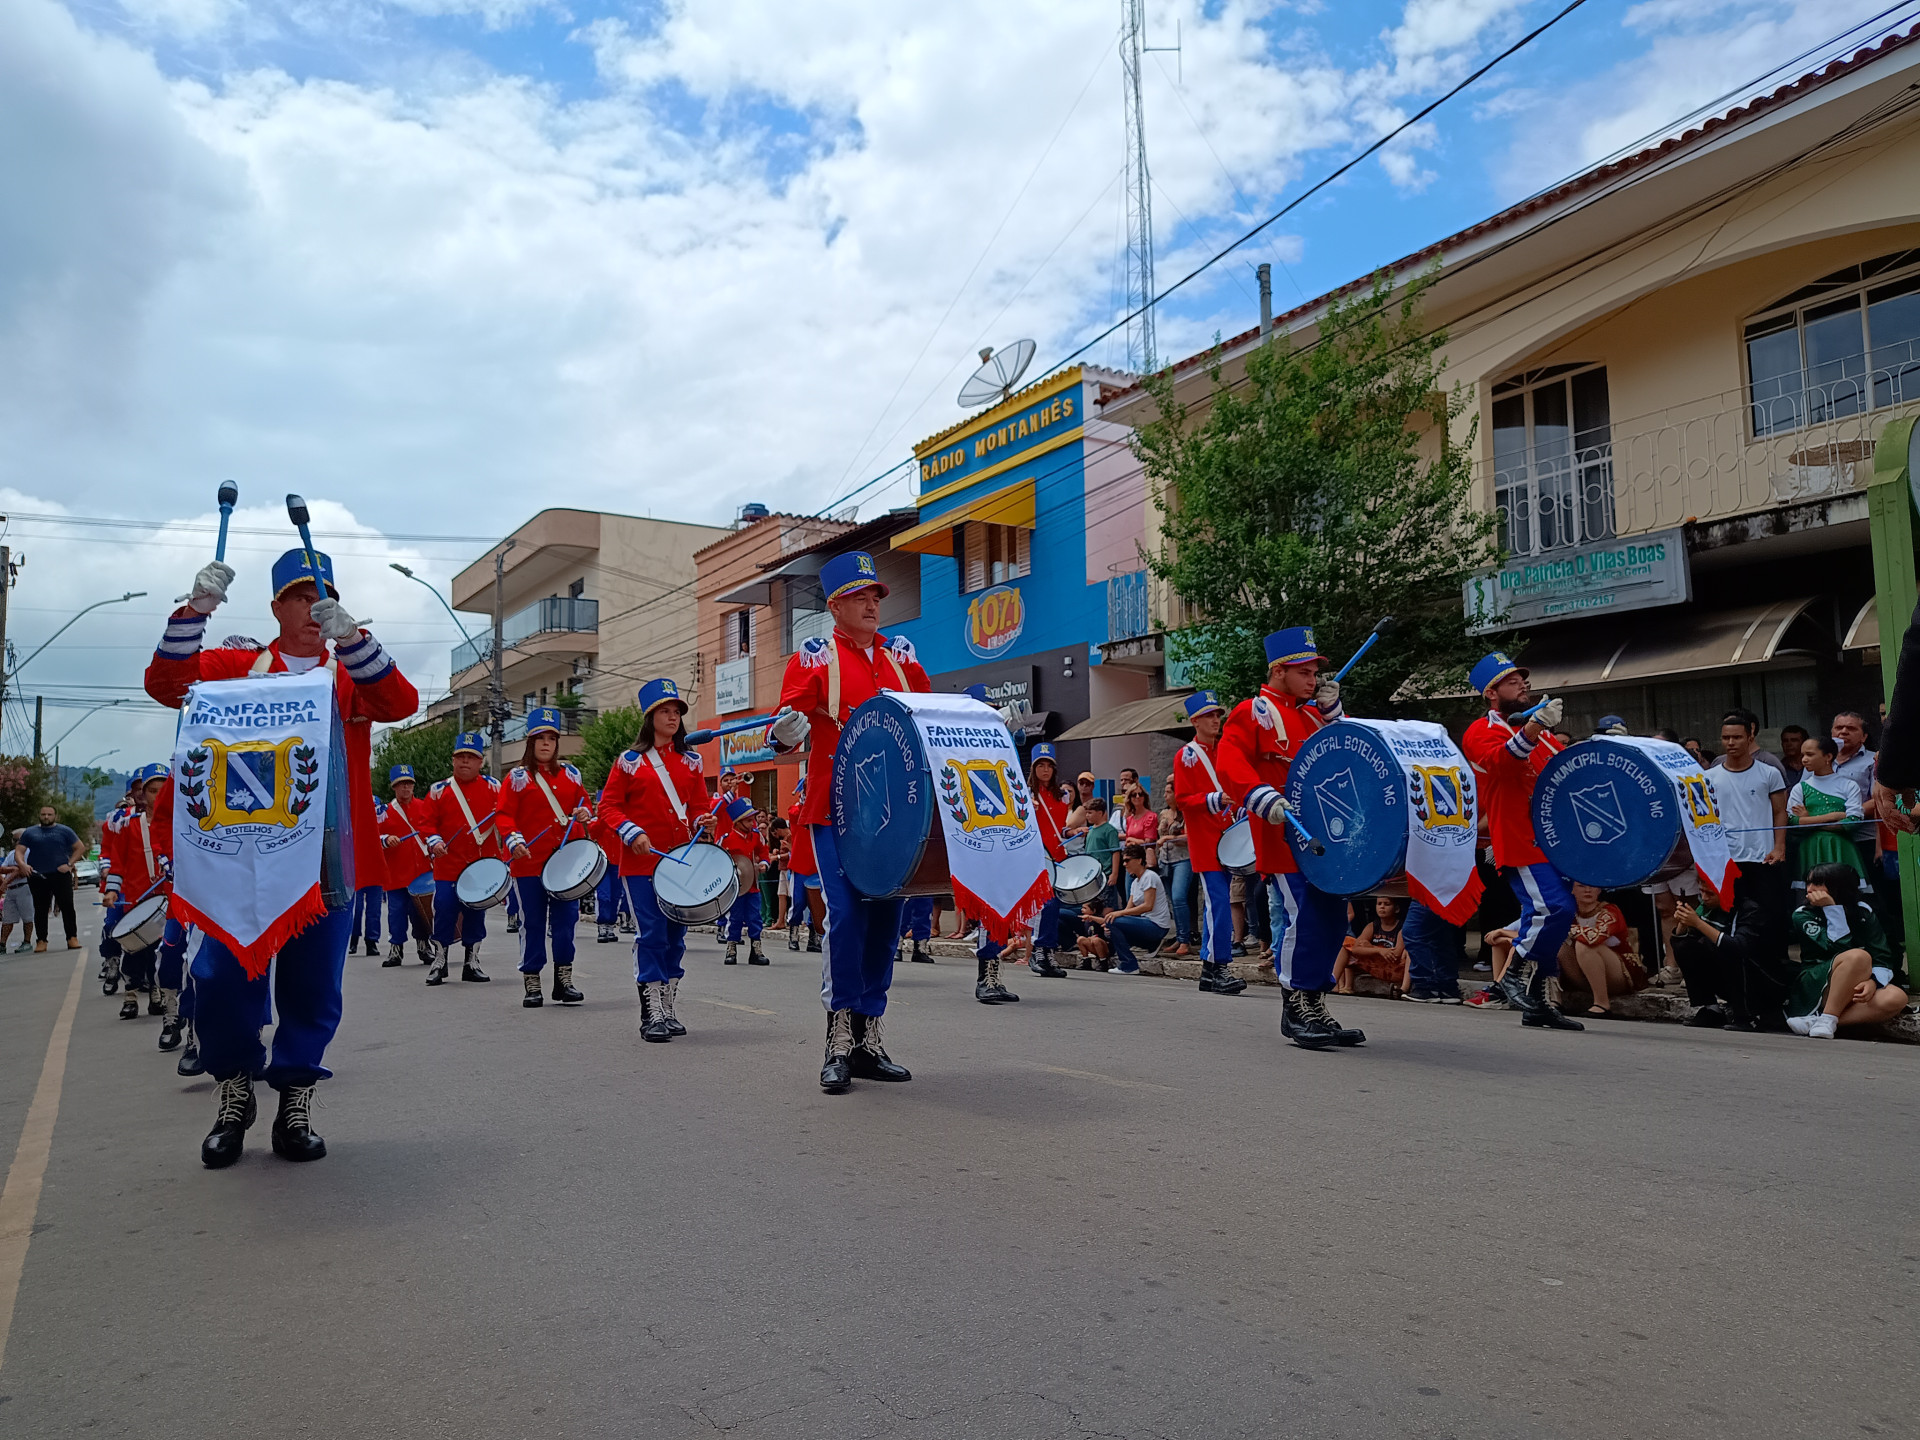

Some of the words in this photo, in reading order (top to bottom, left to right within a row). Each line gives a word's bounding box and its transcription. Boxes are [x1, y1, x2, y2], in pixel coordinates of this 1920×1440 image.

[921, 448, 965, 482] RÁDIO
[975, 398, 1074, 458] MONTANHÊS
[1590, 549, 1626, 571] Vilas
[1627, 543, 1666, 565] Boas
[967, 587, 1020, 645] 107.1
[195, 699, 317, 717] FANFARRA
[190, 711, 320, 728] MUNICIPAL
[926, 725, 1004, 739] FANFARRA
[927, 736, 1010, 750] MUNICIPAL
[834, 755, 848, 836] FANFARRA
[844, 710, 881, 755] MUNICIPAL
[883, 711, 915, 772] BOTELHOS
[907, 780, 918, 805] MG
[1296, 735, 1342, 781] MUNICIPAL
[1344, 735, 1389, 780] BOTELHOS
[1382, 784, 1396, 807] MG
[1550, 752, 1604, 788] MUNICIPAL
[1607, 753, 1657, 797] BOTELHOS
[1540, 786, 1561, 848] FANFARRA
[1649, 800, 1664, 819] MG
[225, 825, 273, 835] BOTELHOS
[981, 827, 1011, 836] BOTELHOS
[197, 837, 223, 851] 1845
[963, 837, 982, 849] 1845
[702, 876, 723, 897] GOPE
